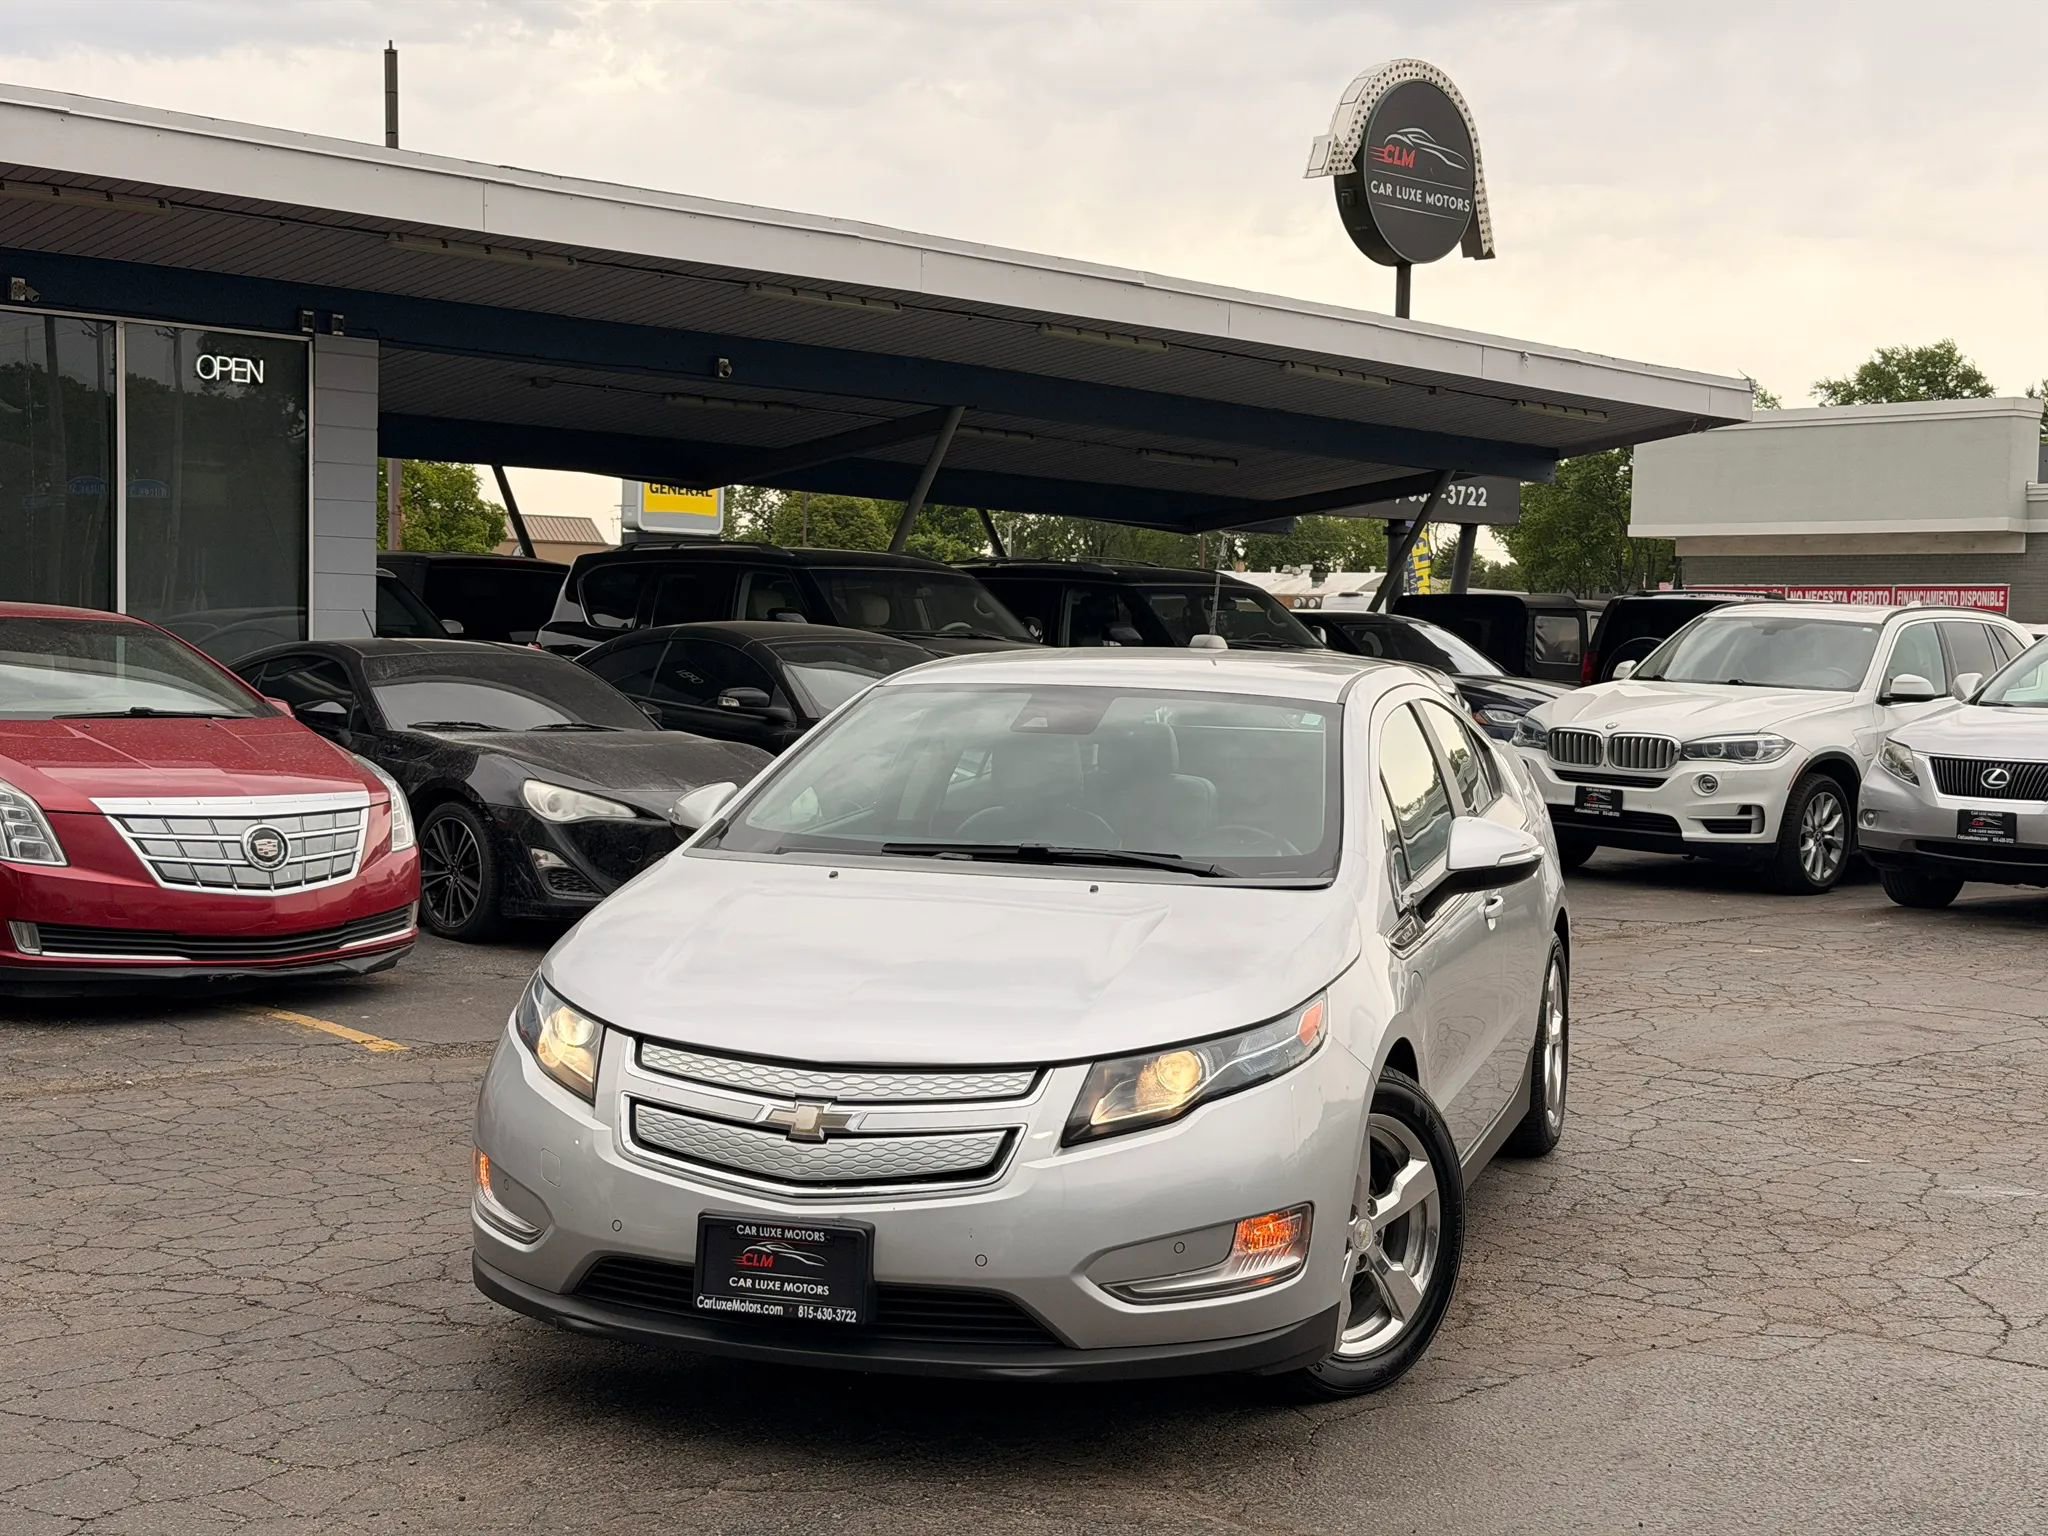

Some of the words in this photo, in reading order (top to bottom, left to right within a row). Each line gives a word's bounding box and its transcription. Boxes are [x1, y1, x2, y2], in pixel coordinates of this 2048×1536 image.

[1383, 144, 1416, 169] CLM
[1370, 180, 1393, 197] CAR
[1396, 185, 1423, 203] LUXE
[1426, 191, 1470, 212] MOTORS
[196, 354, 264, 384] OPEN
[649, 482, 713, 498] GENERAL
[1850, 590, 1890, 606] CREDITO
[1896, 590, 1959, 606] FINANCIAMIENTO
[1960, 590, 2005, 607] DISPONIBLE
[736, 1224, 757, 1236] CAR
[760, 1226, 782, 1239] LUXE
[784, 1228, 826, 1242] MOTORS
[742, 1252, 774, 1268] CLM
[729, 1276, 752, 1289] CAR
[755, 1279, 781, 1291] LUXE
[783, 1282, 830, 1296] MOTORS
[696, 1295, 784, 1316] CarLuxeMotors.com
[797, 1304, 857, 1323] 815-630-3722
